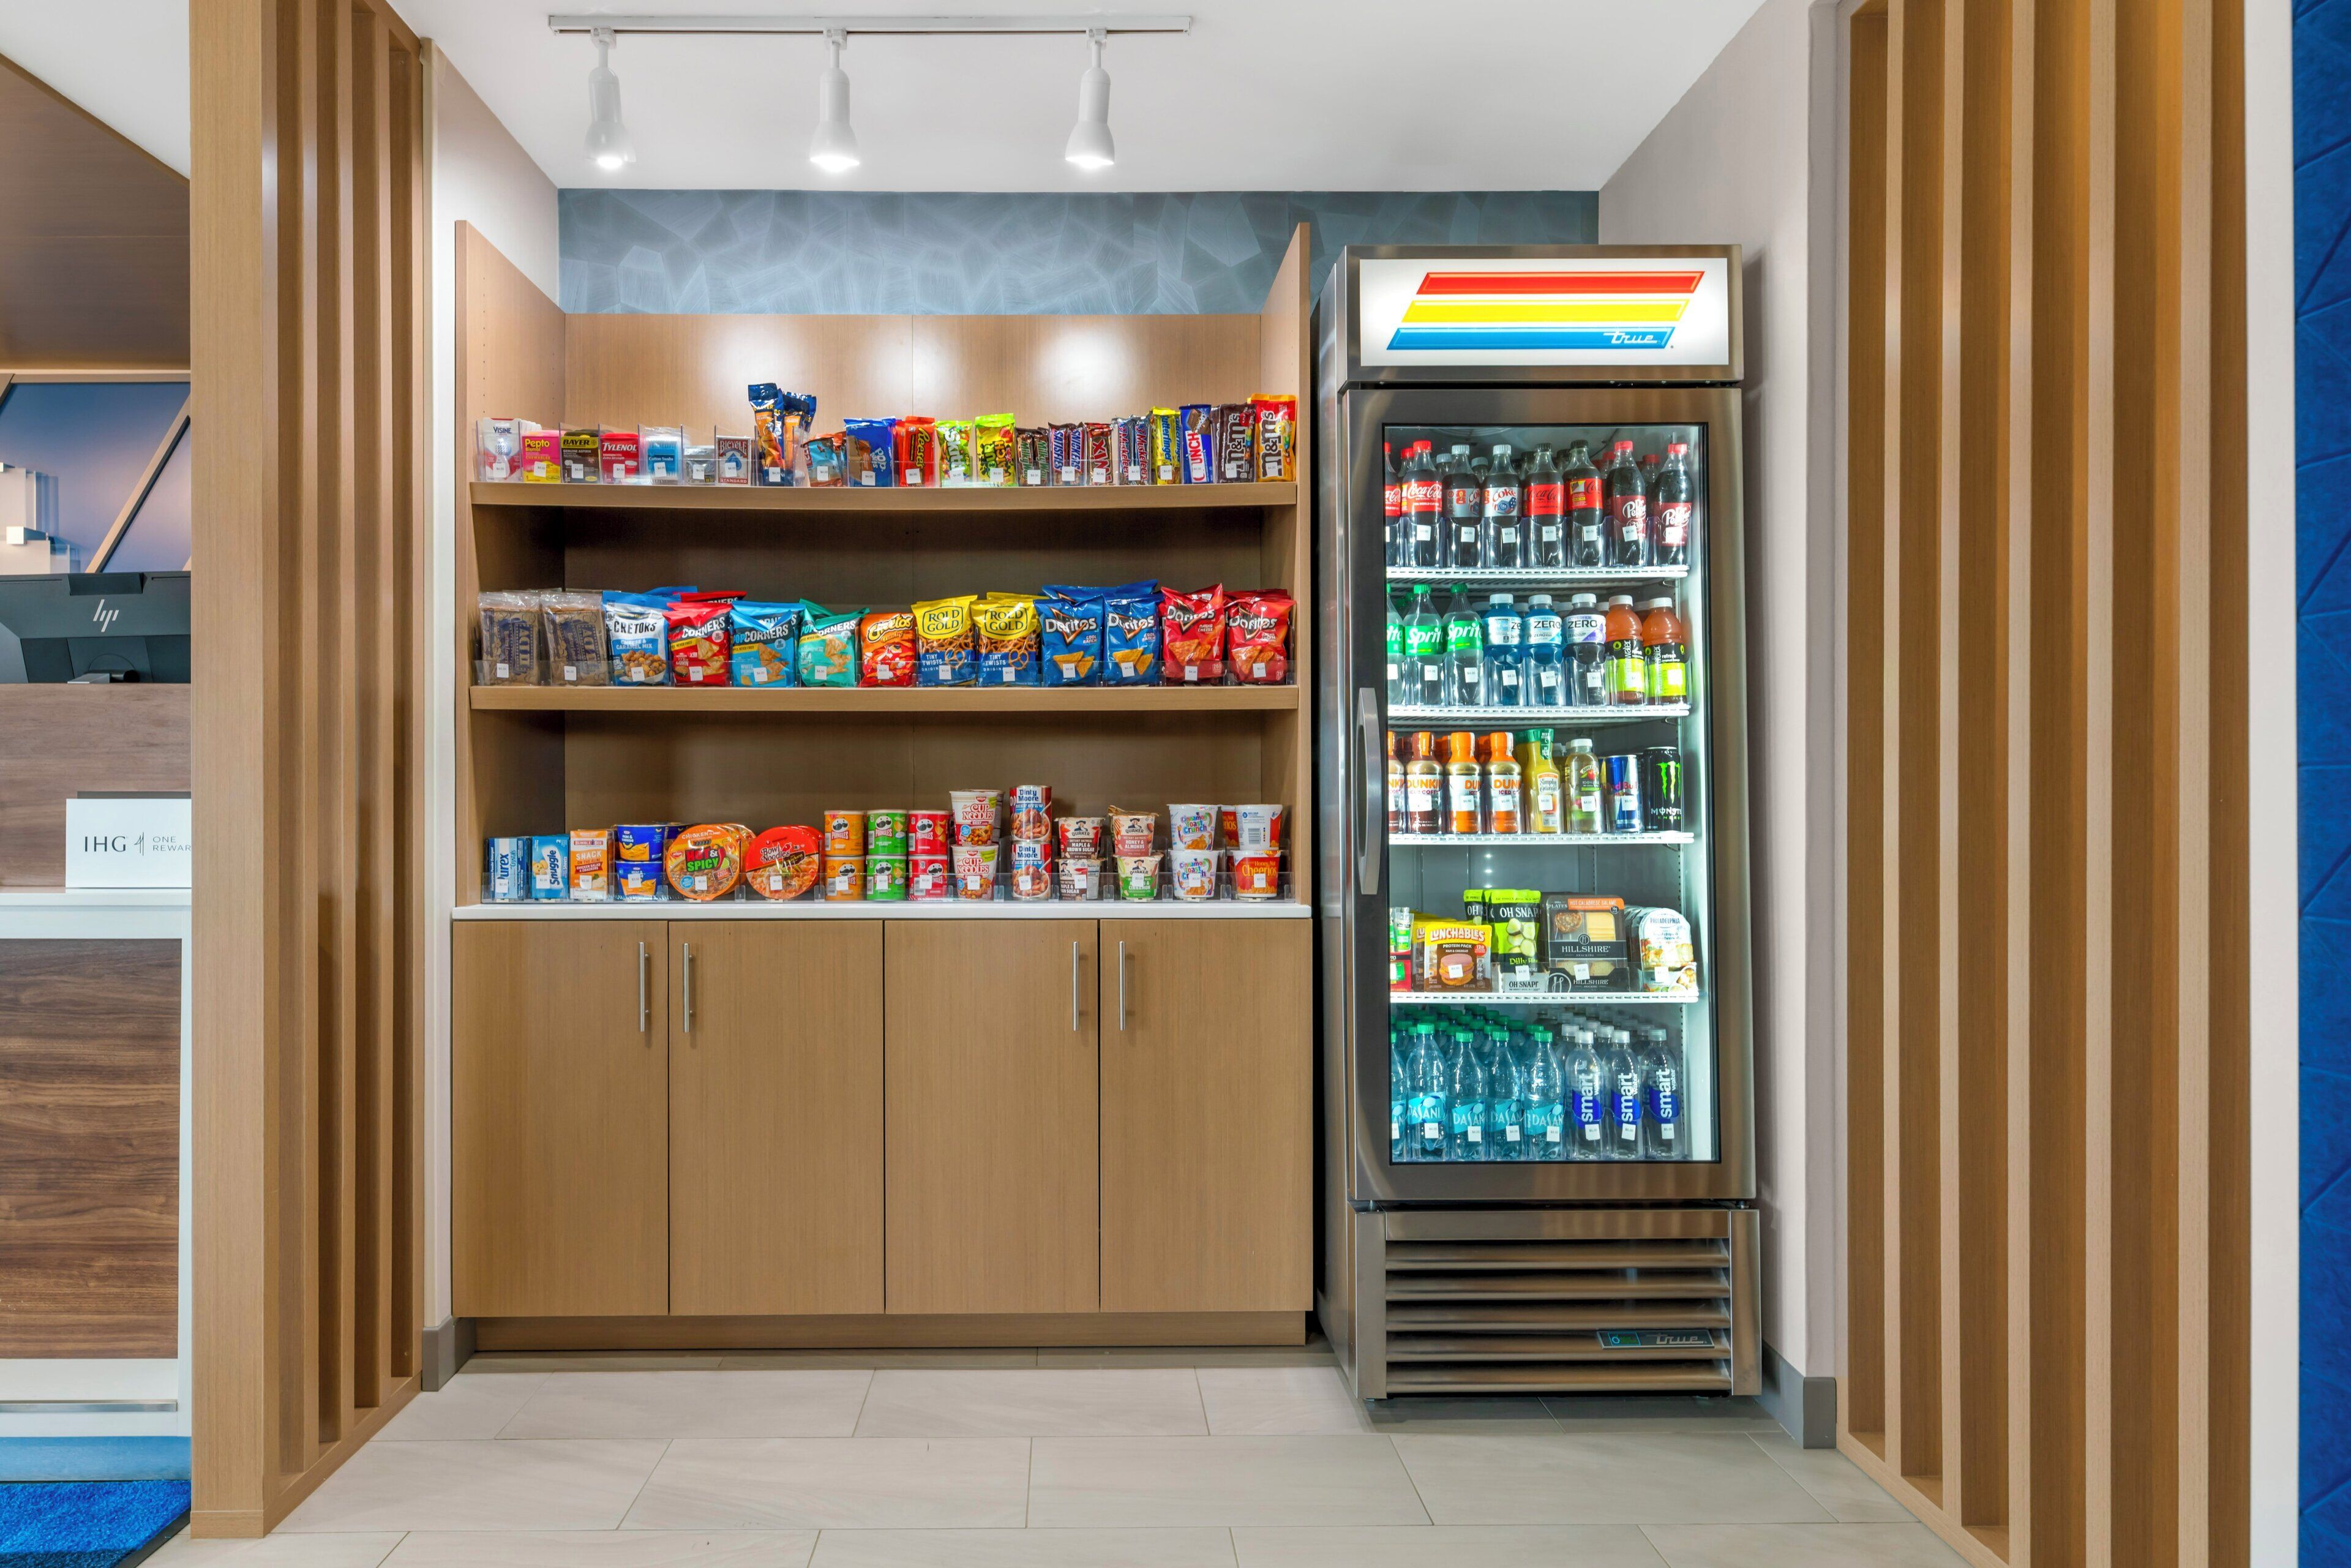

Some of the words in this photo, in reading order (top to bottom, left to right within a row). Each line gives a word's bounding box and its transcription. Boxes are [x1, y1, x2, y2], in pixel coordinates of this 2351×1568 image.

[525, 439, 550, 448] Pepto
[602, 443, 637, 452] TYLENOL
[719, 441, 747, 455] BICYCLE
[1070, 429, 1082, 471] SNICKERS
[1136, 433, 1149, 481] Musketeers
[1493, 488, 1516, 502] Coke
[92, 599, 119, 632] hp
[929, 610, 959, 621] ROLD
[990, 610, 1023, 620] ROLD
[1167, 606, 1215, 621] Doritos
[867, 613, 913, 642] Cheetos
[927, 621, 959, 632] GOLD
[989, 621, 1024, 632] GOLD
[1045, 618, 1097, 632] Doritos
[1109, 613, 1155, 629] Doritos
[1229, 617, 1278, 629] Doritos
[1534, 620, 1561, 629] ZERO
[1567, 620, 1597, 629] ZERO
[970, 804, 990, 812] CUP
[962, 811, 994, 820] NOODLES
[1183, 826, 1207, 835] Crunch
[84, 836, 126, 852] IHG
[760, 845, 781, 856] Bowl
[576, 851, 601, 860] SNACK
[686, 848, 711, 861] HOT
[761, 850, 791, 863] Noodles
[497, 853, 509, 880] urex
[547, 850, 560, 885] Snuggle
[687, 858, 719, 872] SPICY
[957, 865, 989, 874] NOODLES
[1179, 860, 1206, 869] Cinnamon
[1242, 864, 1277, 877] Cheerios
[1500, 907, 1513, 918] OH
[1430, 929, 1485, 942] LUNCHABLES
[1579, 1073, 1594, 1122] smart
[1618, 1073, 1633, 1122] smart
[1656, 1068, 1673, 1117] smart
